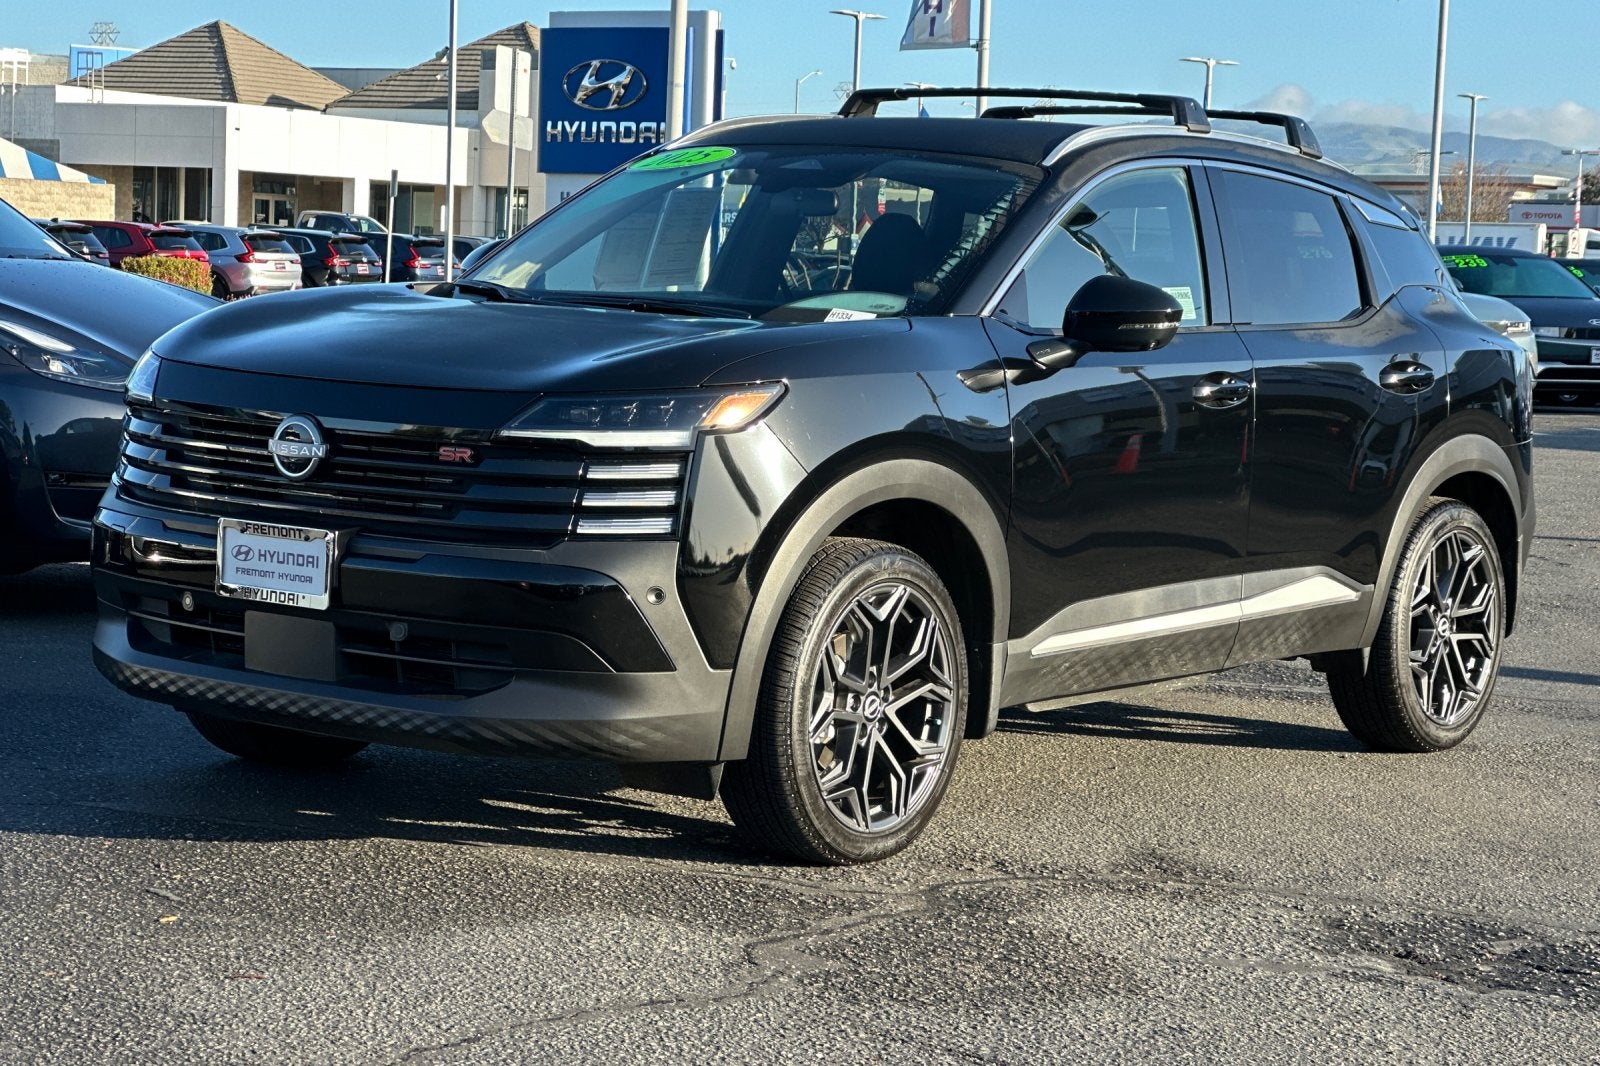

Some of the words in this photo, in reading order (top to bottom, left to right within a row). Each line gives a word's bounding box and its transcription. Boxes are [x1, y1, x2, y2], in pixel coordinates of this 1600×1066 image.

[546, 120, 666, 144] HYUNDAI
[1455, 258, 1488, 268] 239
[829, 311, 854, 320] H1334
[269, 441, 323, 457] NISSAN
[439, 446, 474, 463] SR
[245, 522, 303, 539] FREMONT
[258, 549, 319, 569] HYUNDAI
[235, 566, 275, 579] FREMONT
[278, 572, 313, 584] HYUNDAI
[243, 587, 299, 605] HYUNDAI
